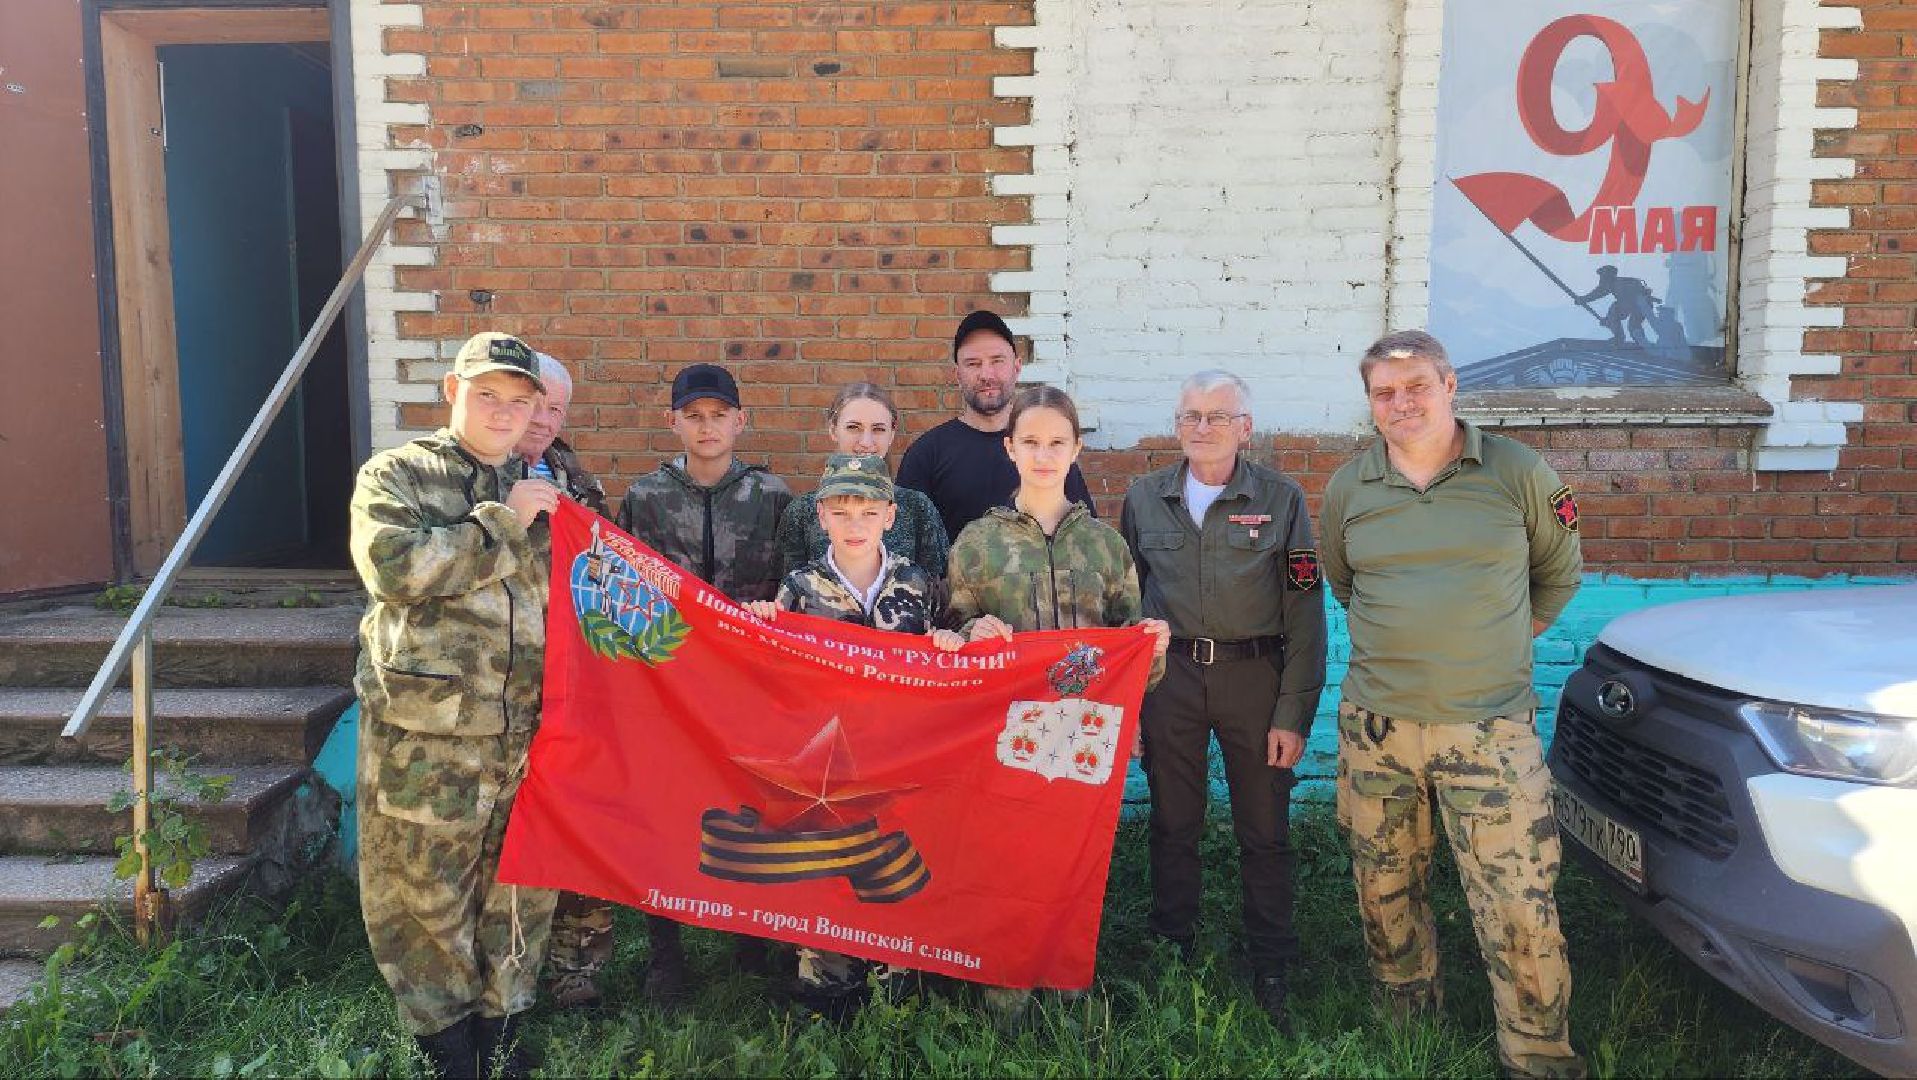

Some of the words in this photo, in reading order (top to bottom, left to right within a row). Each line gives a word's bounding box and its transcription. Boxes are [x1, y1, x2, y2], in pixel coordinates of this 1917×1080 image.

[1516, 13, 1711, 243] 9
[1589, 205, 1717, 254] МАЯ
[696, 589, 818, 644] Поискй
[824, 639, 886, 663] отряд
[640, 888, 733, 919] Дмитров
[752, 909, 809, 934] город
[815, 915, 913, 953] Воинской
[918, 943, 982, 970] славы
